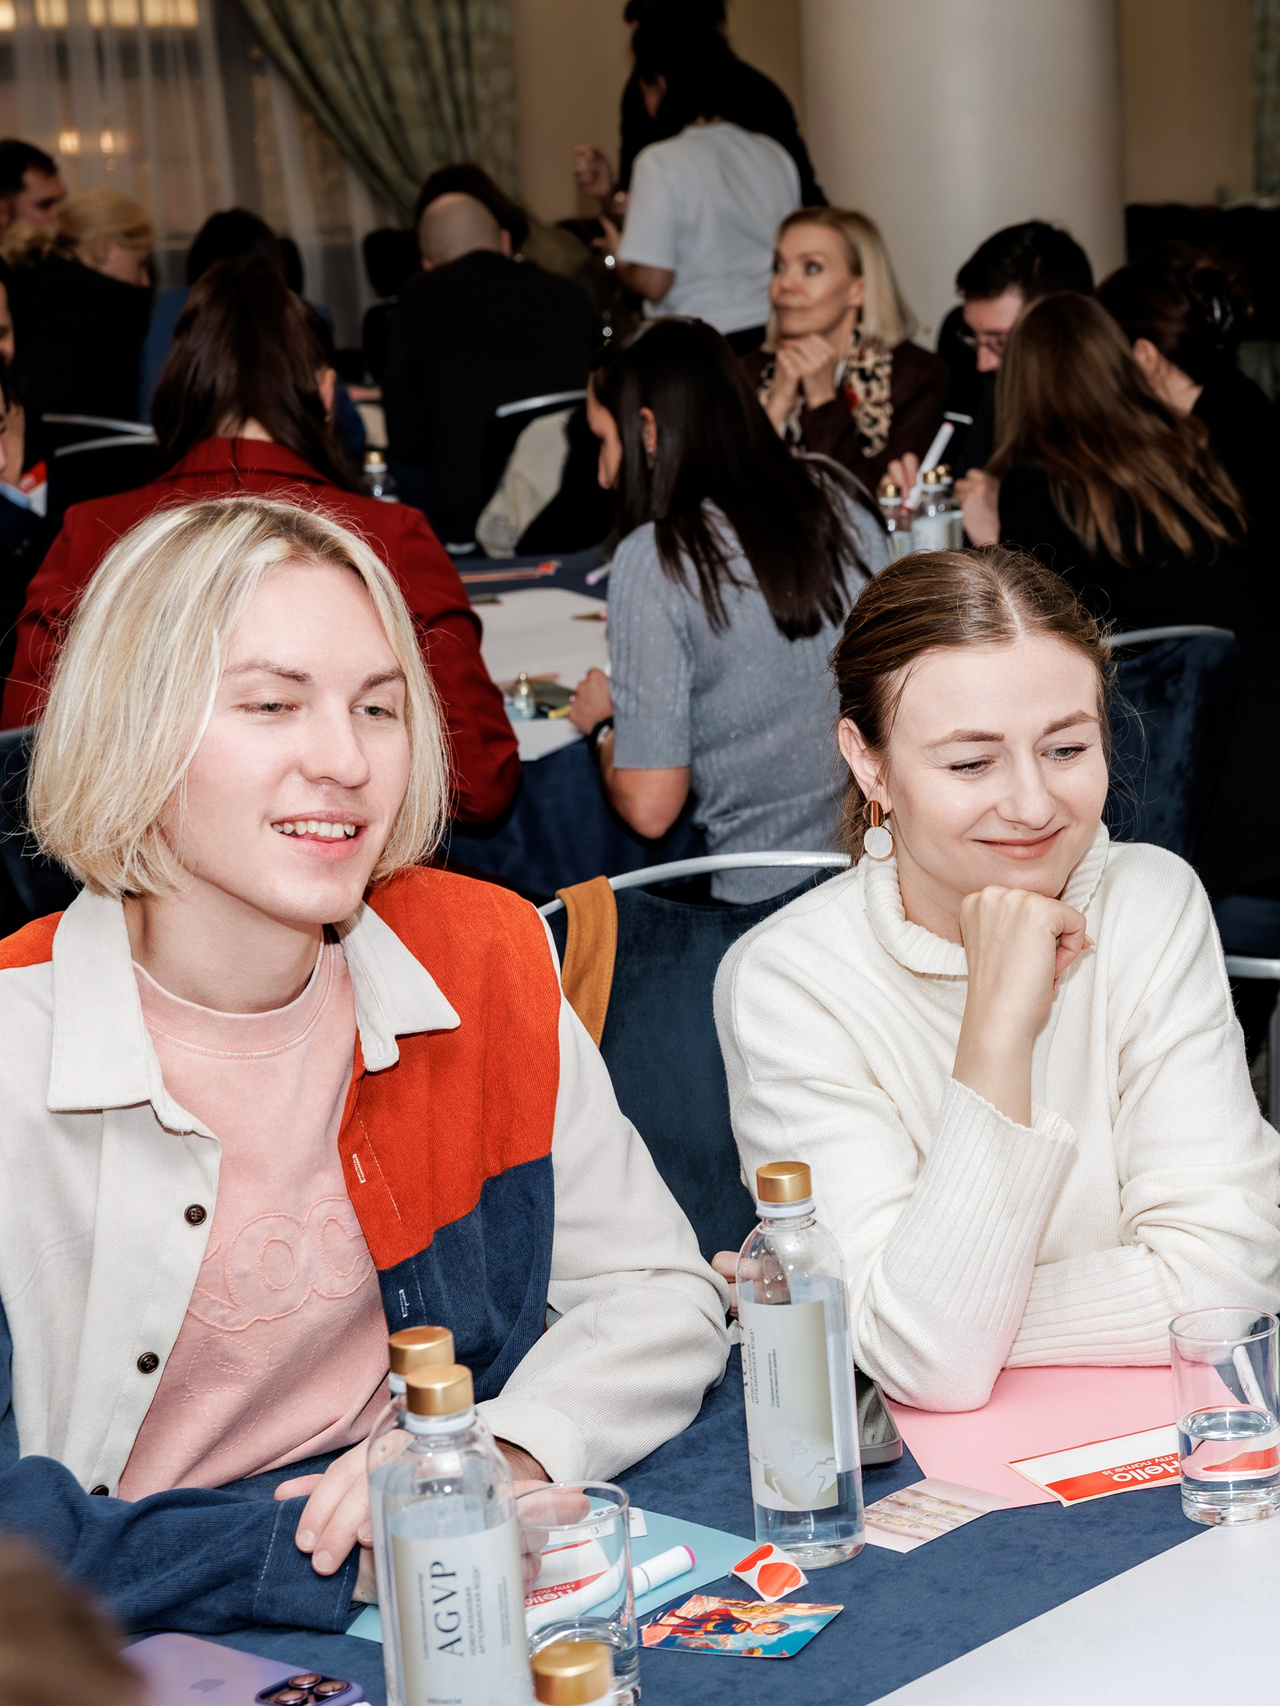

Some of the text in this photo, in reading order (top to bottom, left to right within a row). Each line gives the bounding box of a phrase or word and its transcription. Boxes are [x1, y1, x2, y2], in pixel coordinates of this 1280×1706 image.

[1114, 1461, 1152, 1472] name
[1154, 1455, 1174, 1463] my
[1112, 1460, 1179, 1482] Hello
[429, 1561, 464, 1657] AGVP
